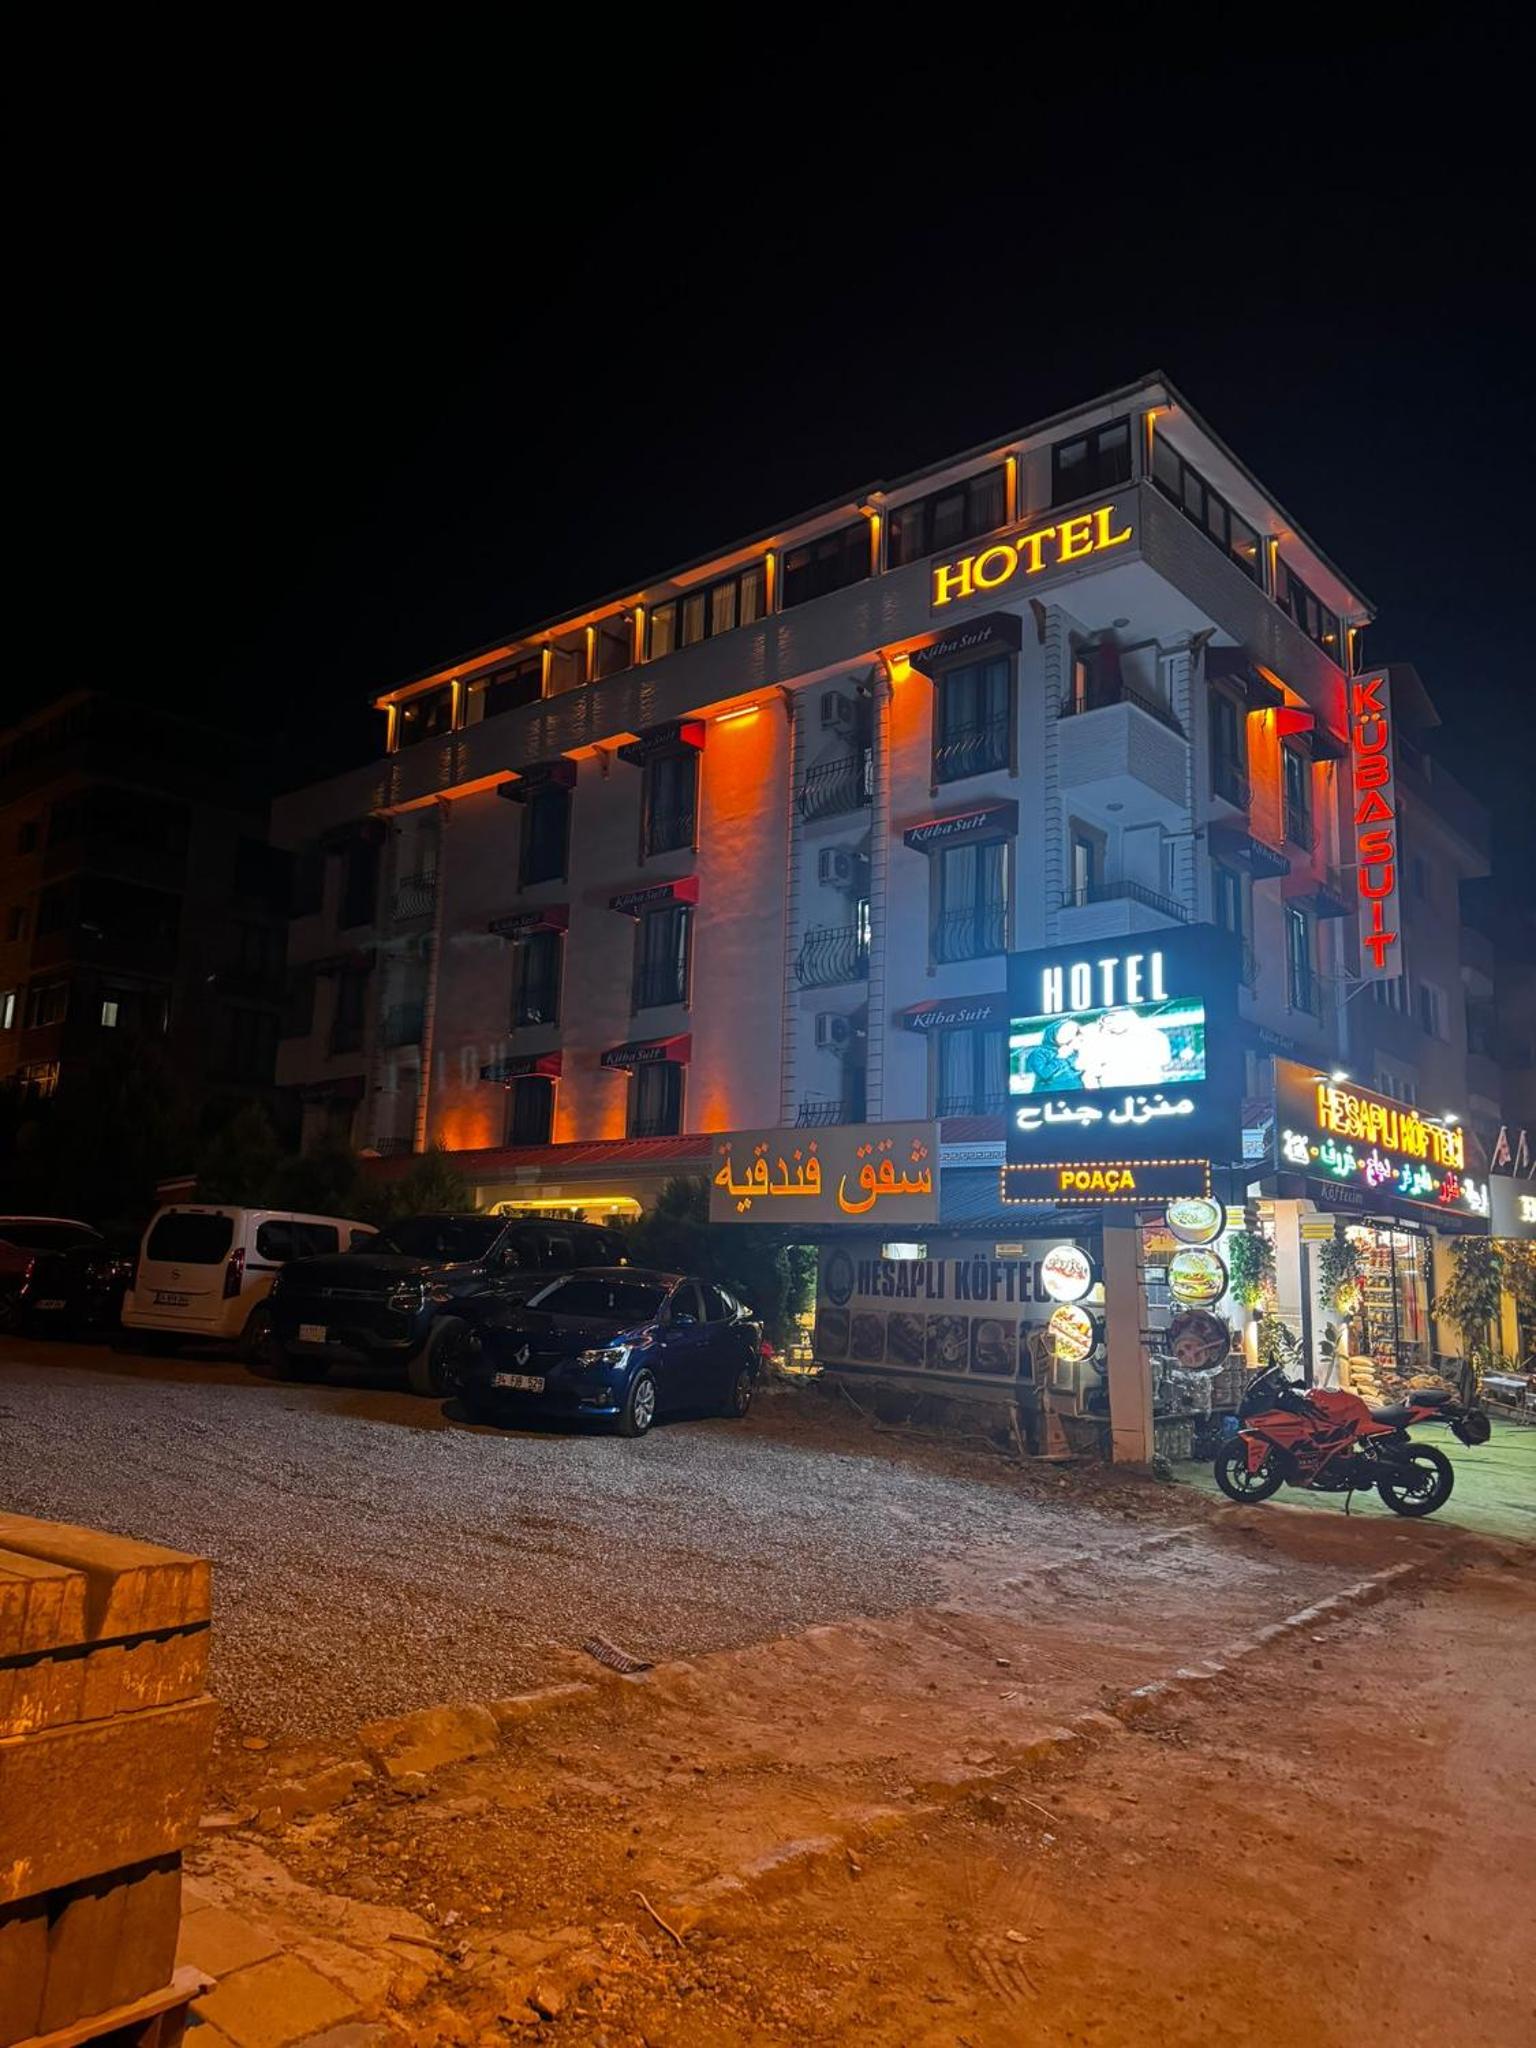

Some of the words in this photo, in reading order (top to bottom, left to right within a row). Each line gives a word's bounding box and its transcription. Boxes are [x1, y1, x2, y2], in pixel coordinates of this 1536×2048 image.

[932, 504, 1133, 606] HOTEL
[1043, 951, 1169, 1014] HOTEL
[957, 1006, 992, 1022] Suit
[1015, 1100, 1104, 1130] جناح
[1108, 1093, 1195, 1125] منزل
[1316, 1084, 1399, 1150] HESAPLI
[713, 1140, 822, 1213] فندقية
[837, 1137, 932, 1214] شقق
[1059, 1170, 1136, 1193] POAÇA
[857, 1259, 944, 1298] HESAPLI
[954, 1255, 1064, 1303] KÖFTEC
